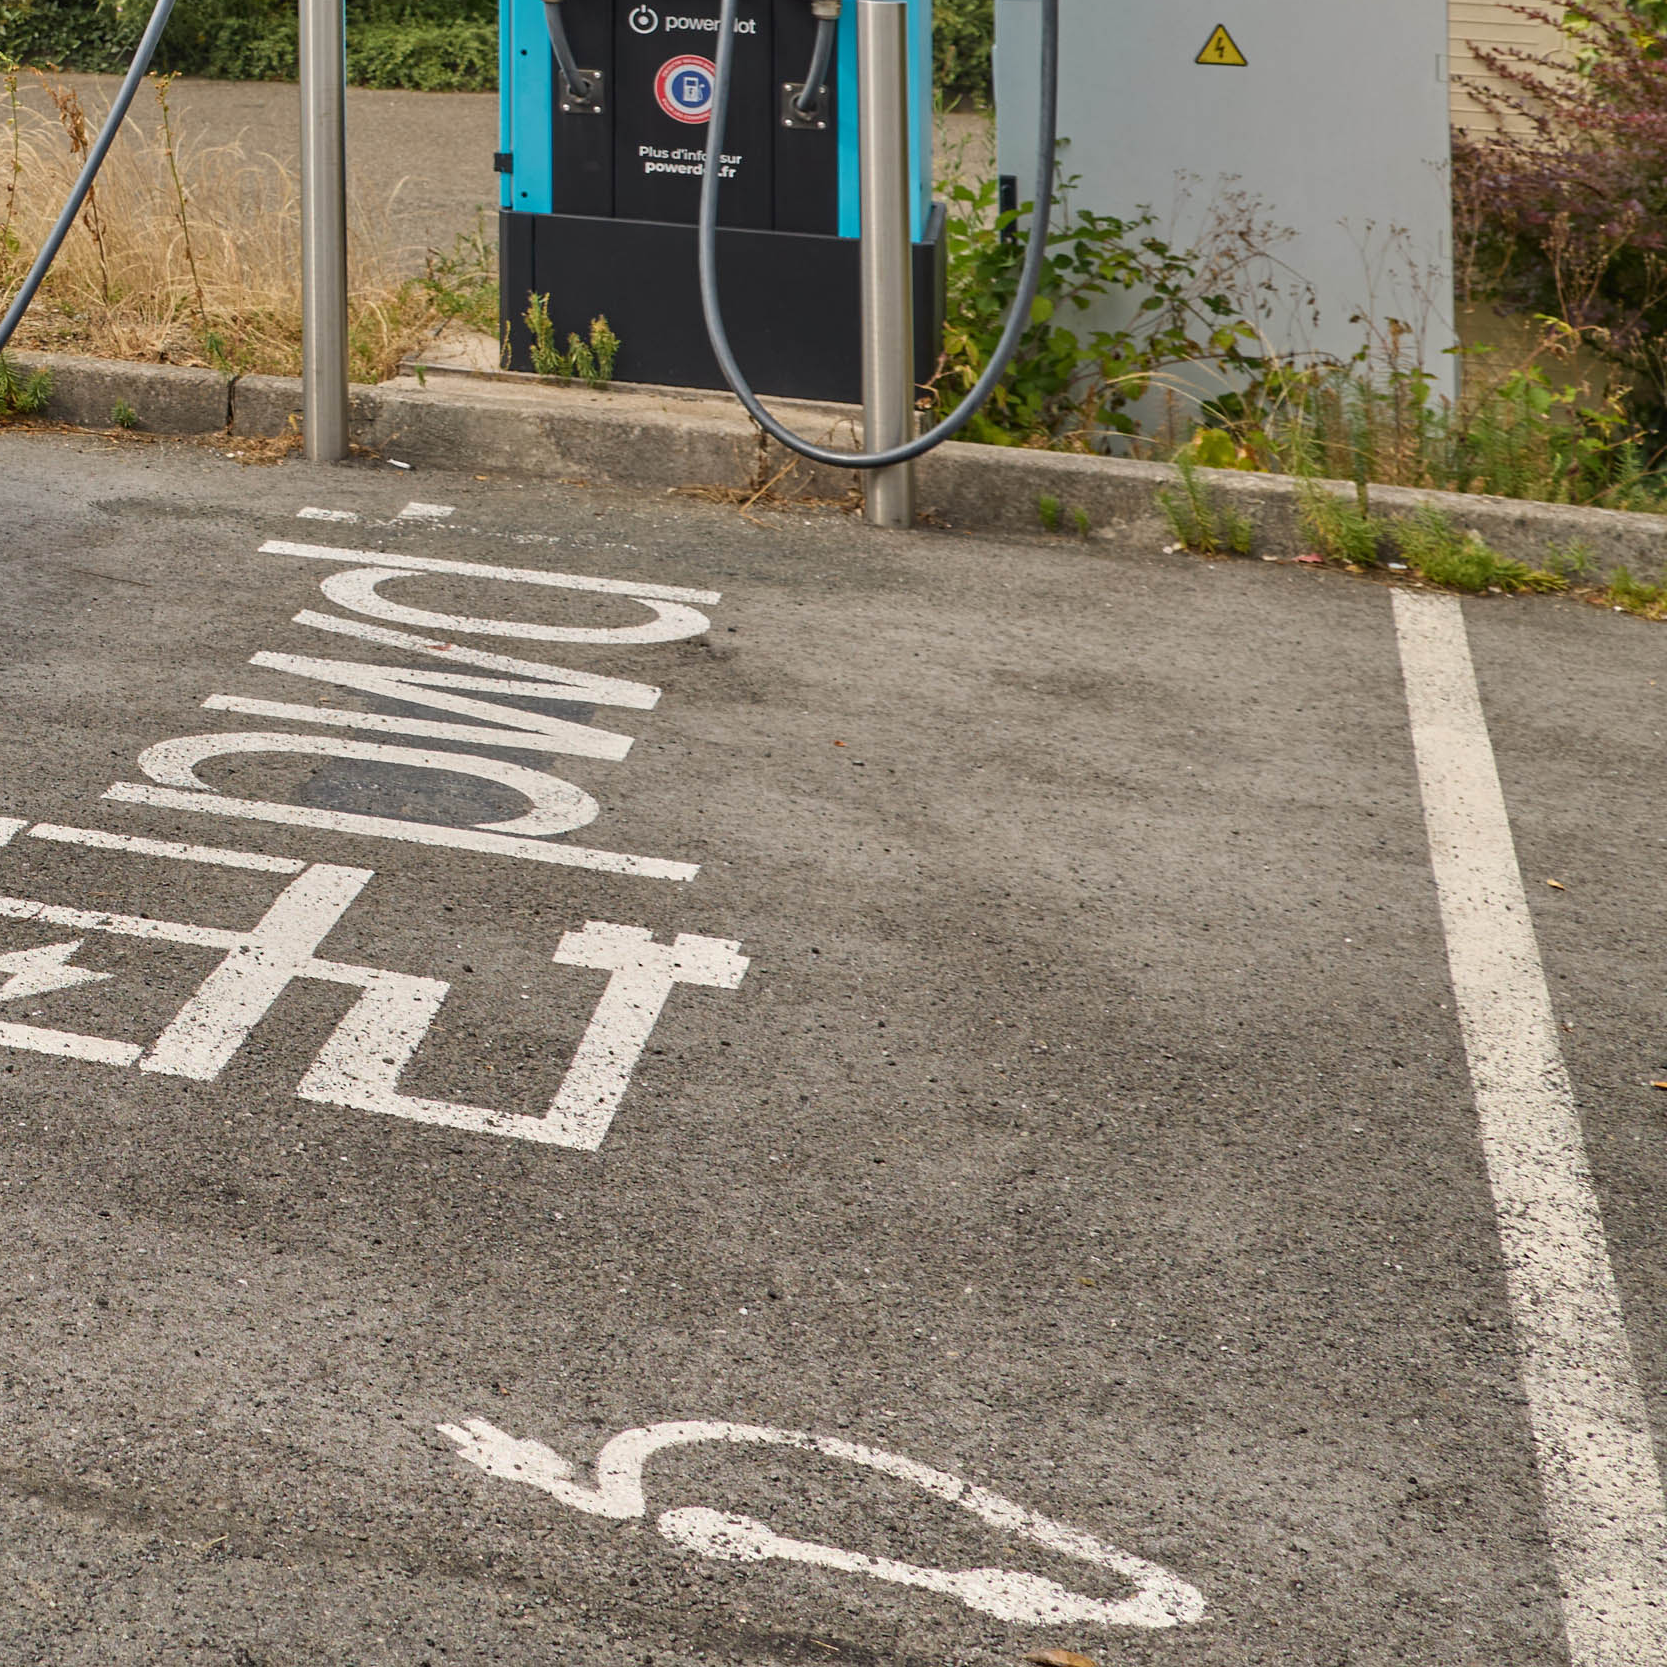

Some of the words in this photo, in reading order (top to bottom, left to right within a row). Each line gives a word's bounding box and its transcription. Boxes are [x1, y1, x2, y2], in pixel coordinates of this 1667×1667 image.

[665, 16, 721, 32] power
[639, 146, 668, 159] Plus
[719, 154, 742, 164] sur
[645, 162, 737, 178] powerd.fr
